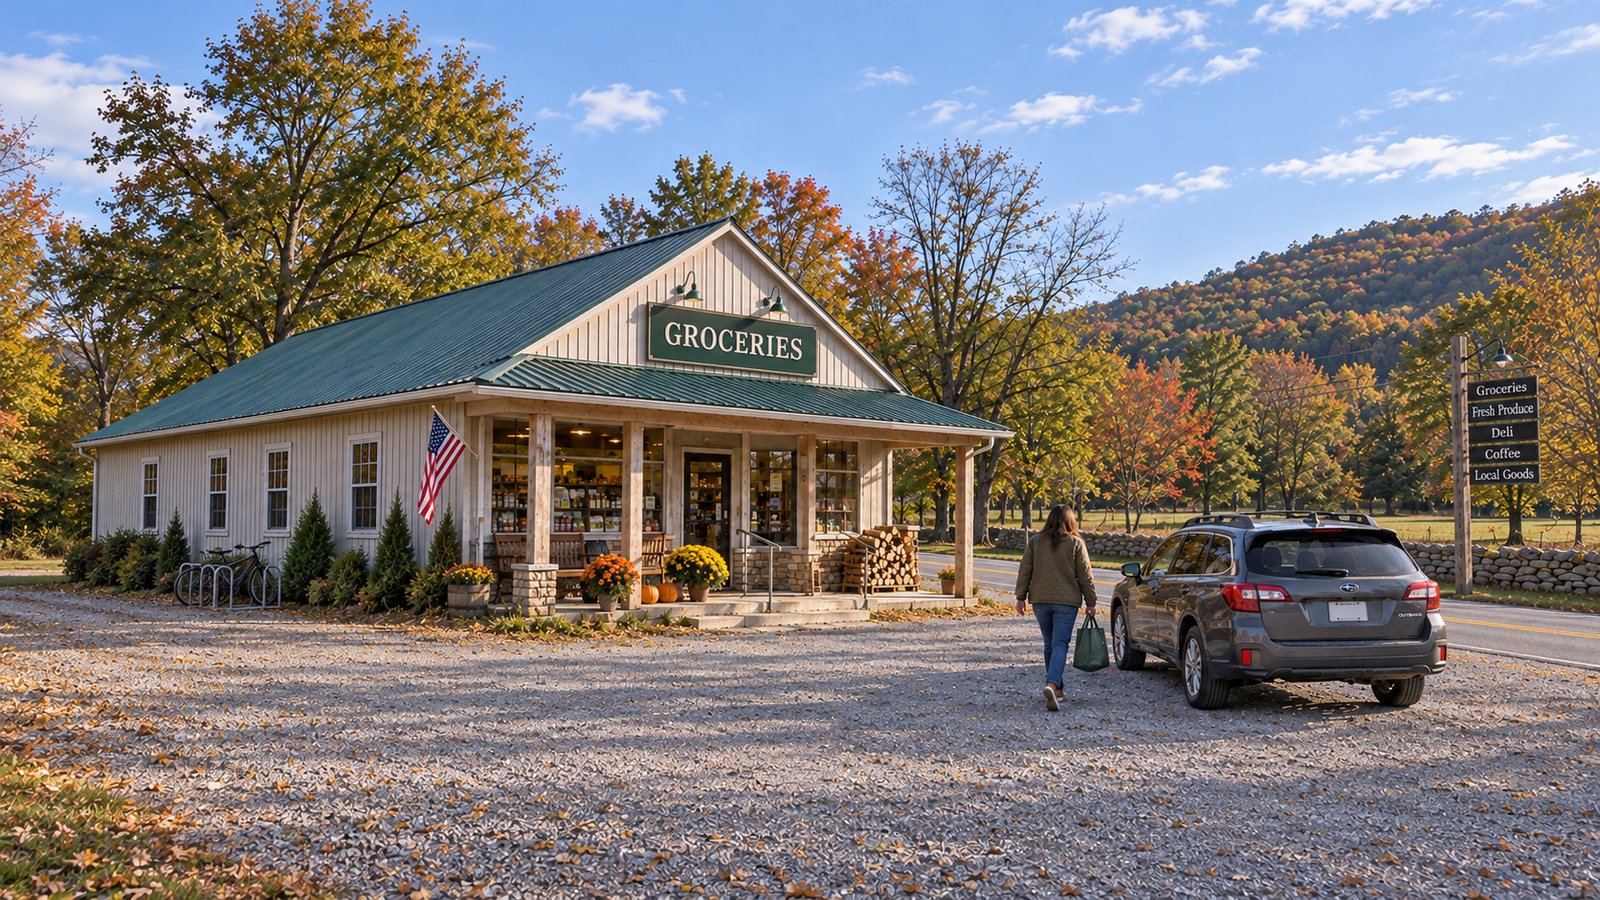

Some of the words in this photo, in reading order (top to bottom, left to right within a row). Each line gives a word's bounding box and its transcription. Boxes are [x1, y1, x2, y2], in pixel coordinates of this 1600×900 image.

[665, 322, 803, 360] GROCERIES
[1476, 382, 1527, 396] Groceries
[1472, 405, 1495, 418] Fresh
[1498, 403, 1534, 416] Produce
[1491, 426, 1514, 438] Deli
[1485, 447, 1520, 460] Coffee
[1475, 469, 1500, 480] Local
[1503, 468, 1534, 480] Goods
